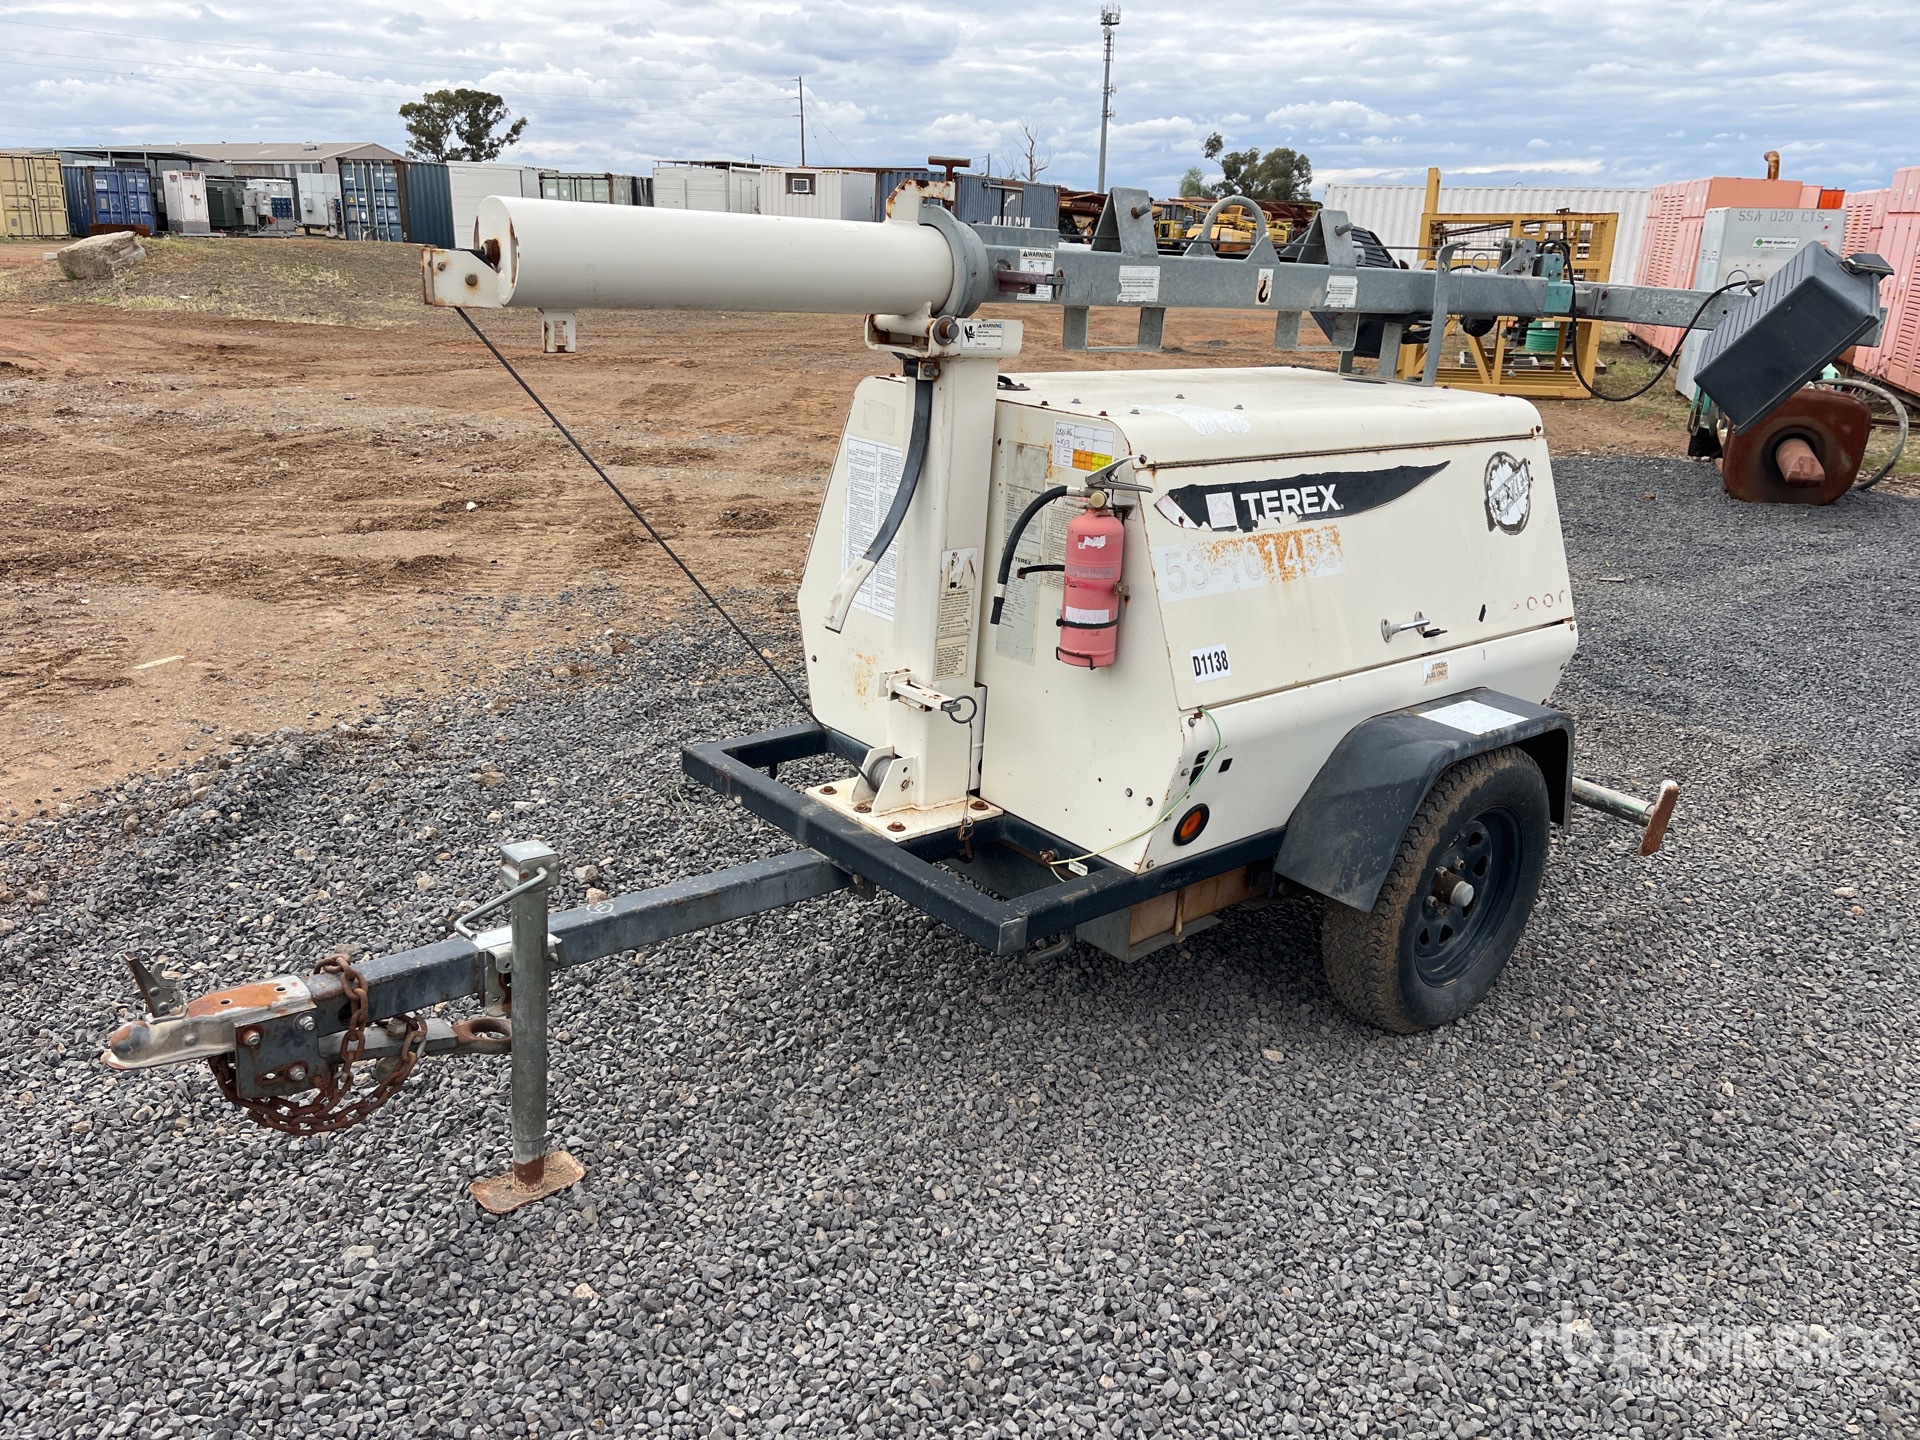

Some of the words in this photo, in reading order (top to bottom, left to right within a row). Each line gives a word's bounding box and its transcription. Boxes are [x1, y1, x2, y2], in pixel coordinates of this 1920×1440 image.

[1801, 210, 1825, 223] CTS
[1240, 483, 1342, 520] TEREX
[1014, 556, 1032, 566] TEREX
[1192, 649, 1230, 677] D1138
